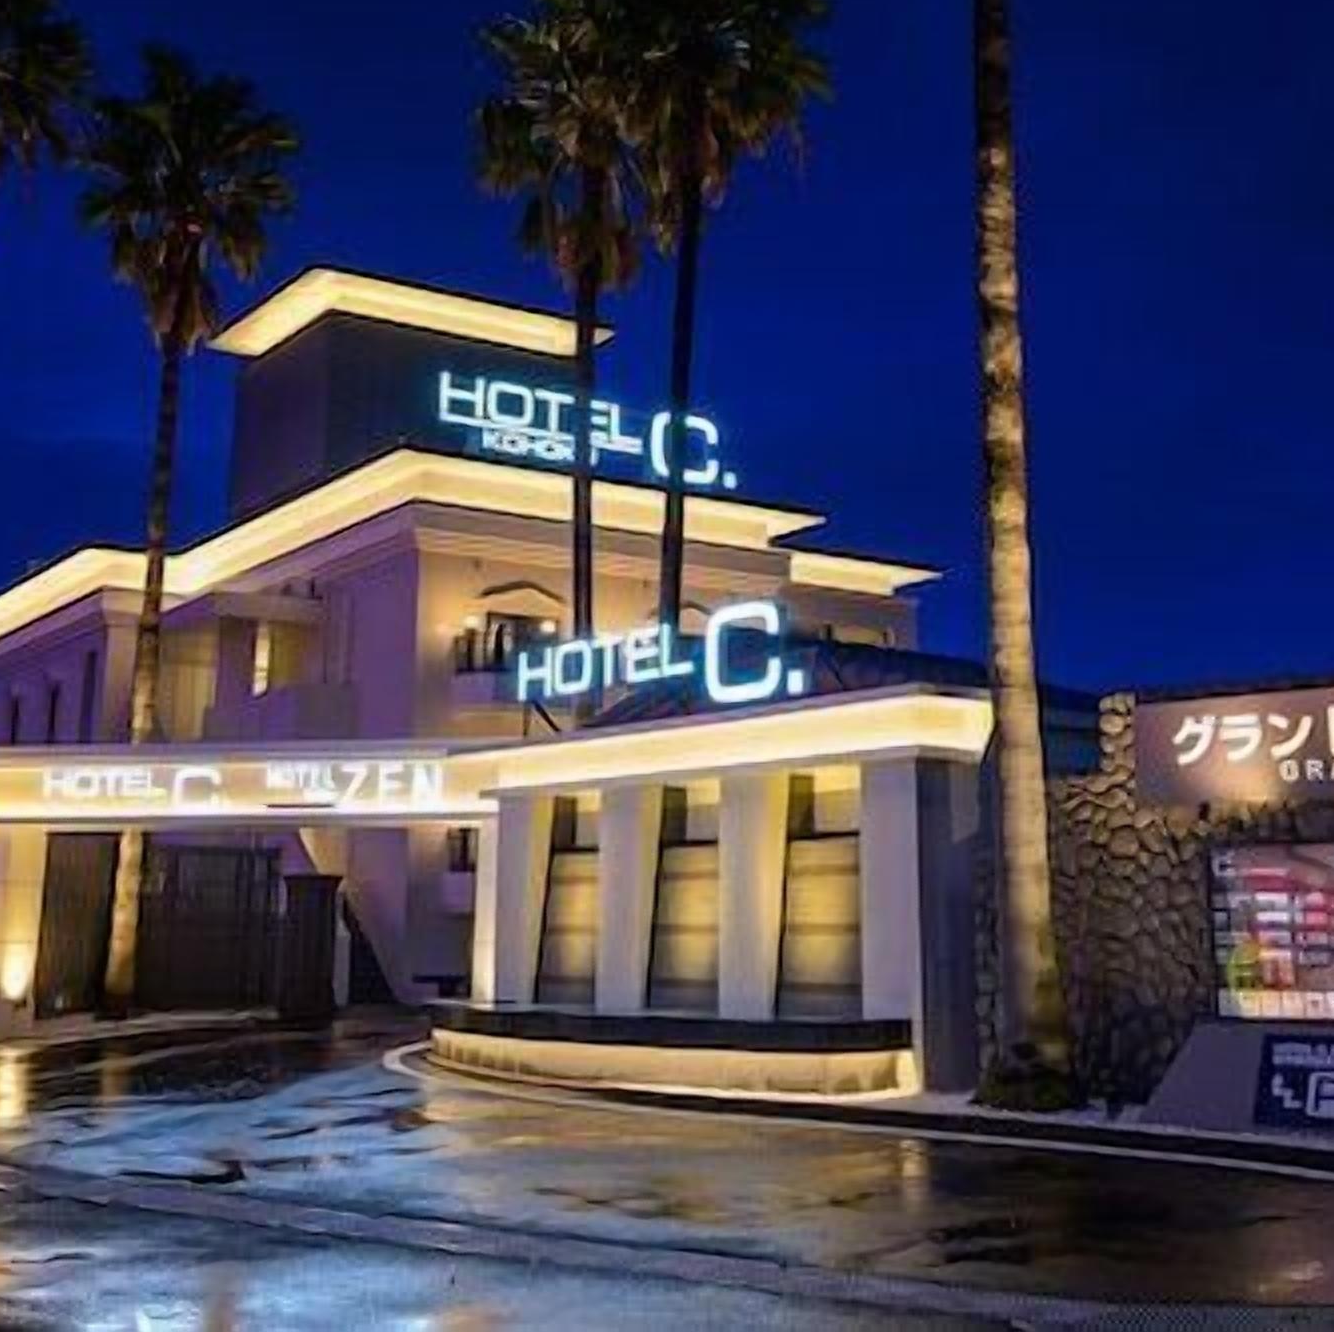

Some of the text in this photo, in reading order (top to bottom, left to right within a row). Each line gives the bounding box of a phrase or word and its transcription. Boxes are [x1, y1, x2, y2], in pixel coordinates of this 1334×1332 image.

[439, 370, 643, 454] HOTEL
[517, 622, 694, 702] HOTEL
[43, 765, 167, 799] HOTEL
[339, 760, 444, 810] ZEN
